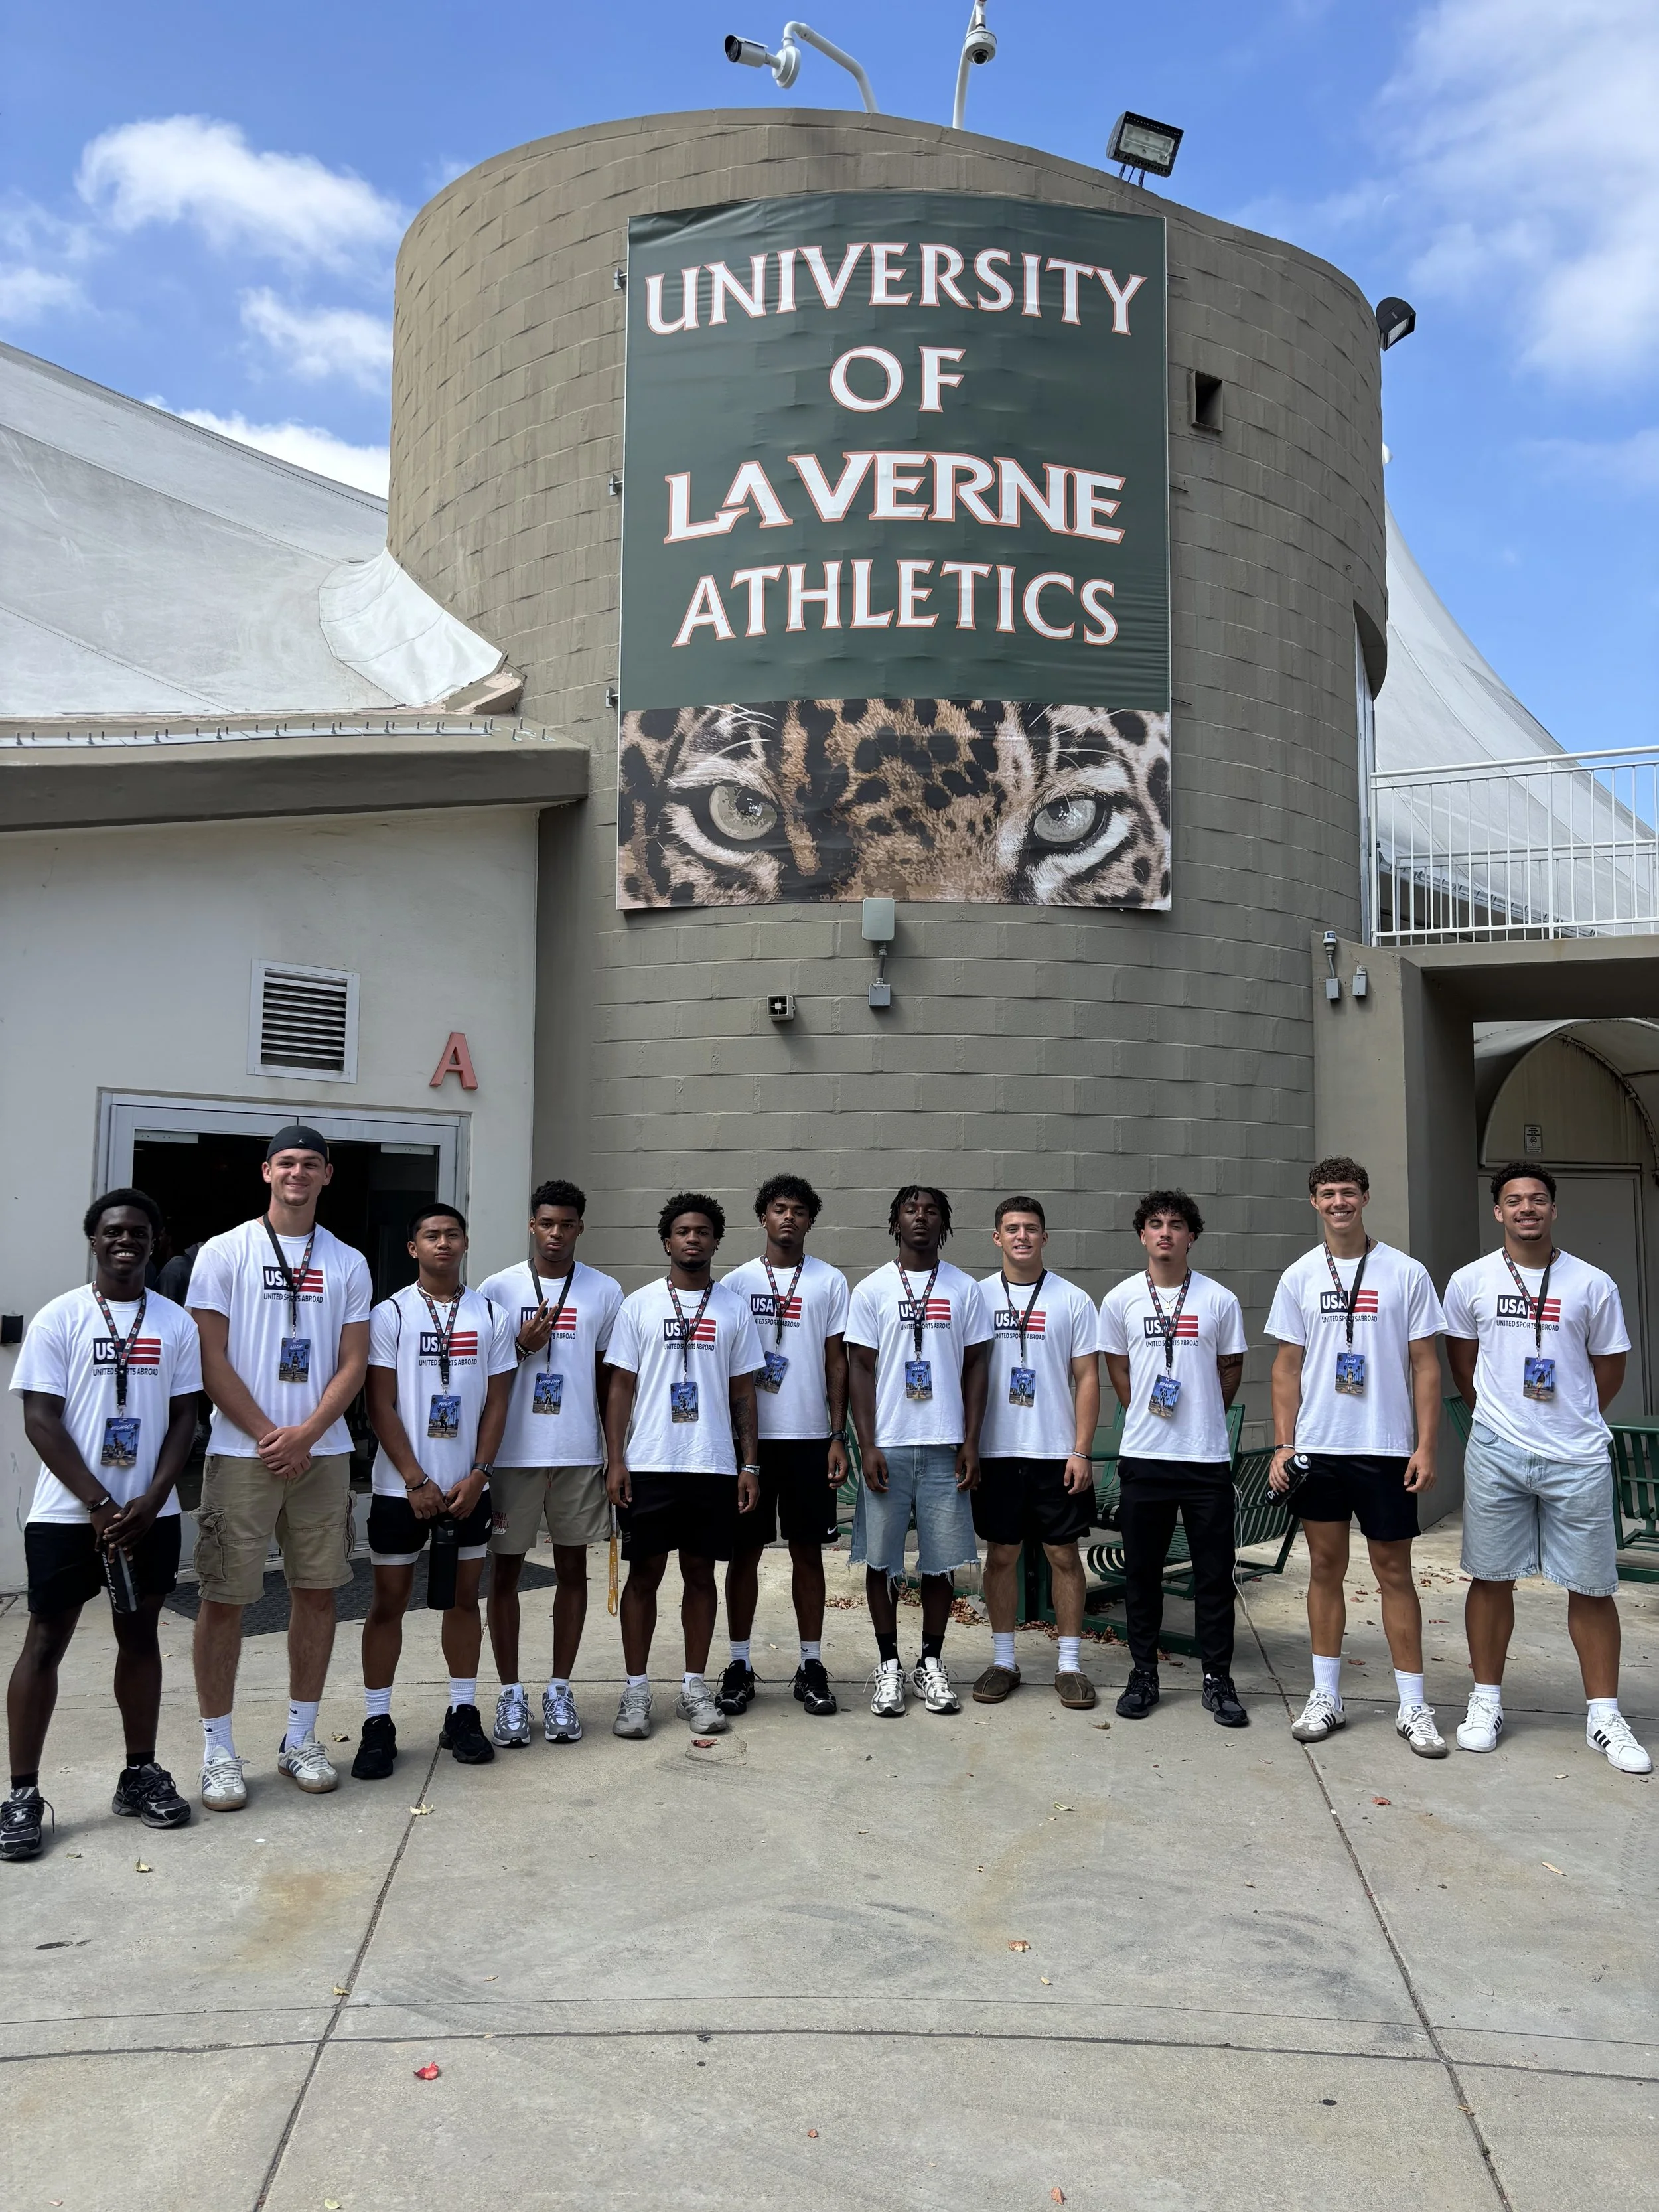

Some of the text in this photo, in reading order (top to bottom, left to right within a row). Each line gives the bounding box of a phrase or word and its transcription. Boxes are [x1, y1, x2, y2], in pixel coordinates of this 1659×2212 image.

[645, 242, 1147, 336] UNIVERSITY
[829, 346, 966, 413] OF
[672, 559, 1118, 648] ATHLETICS
[429, 1032, 478, 1090] A
[752, 1298, 774, 1313] USA
[1500, 1298, 1526, 1315] USA
[422, 1336, 441, 1352] US
